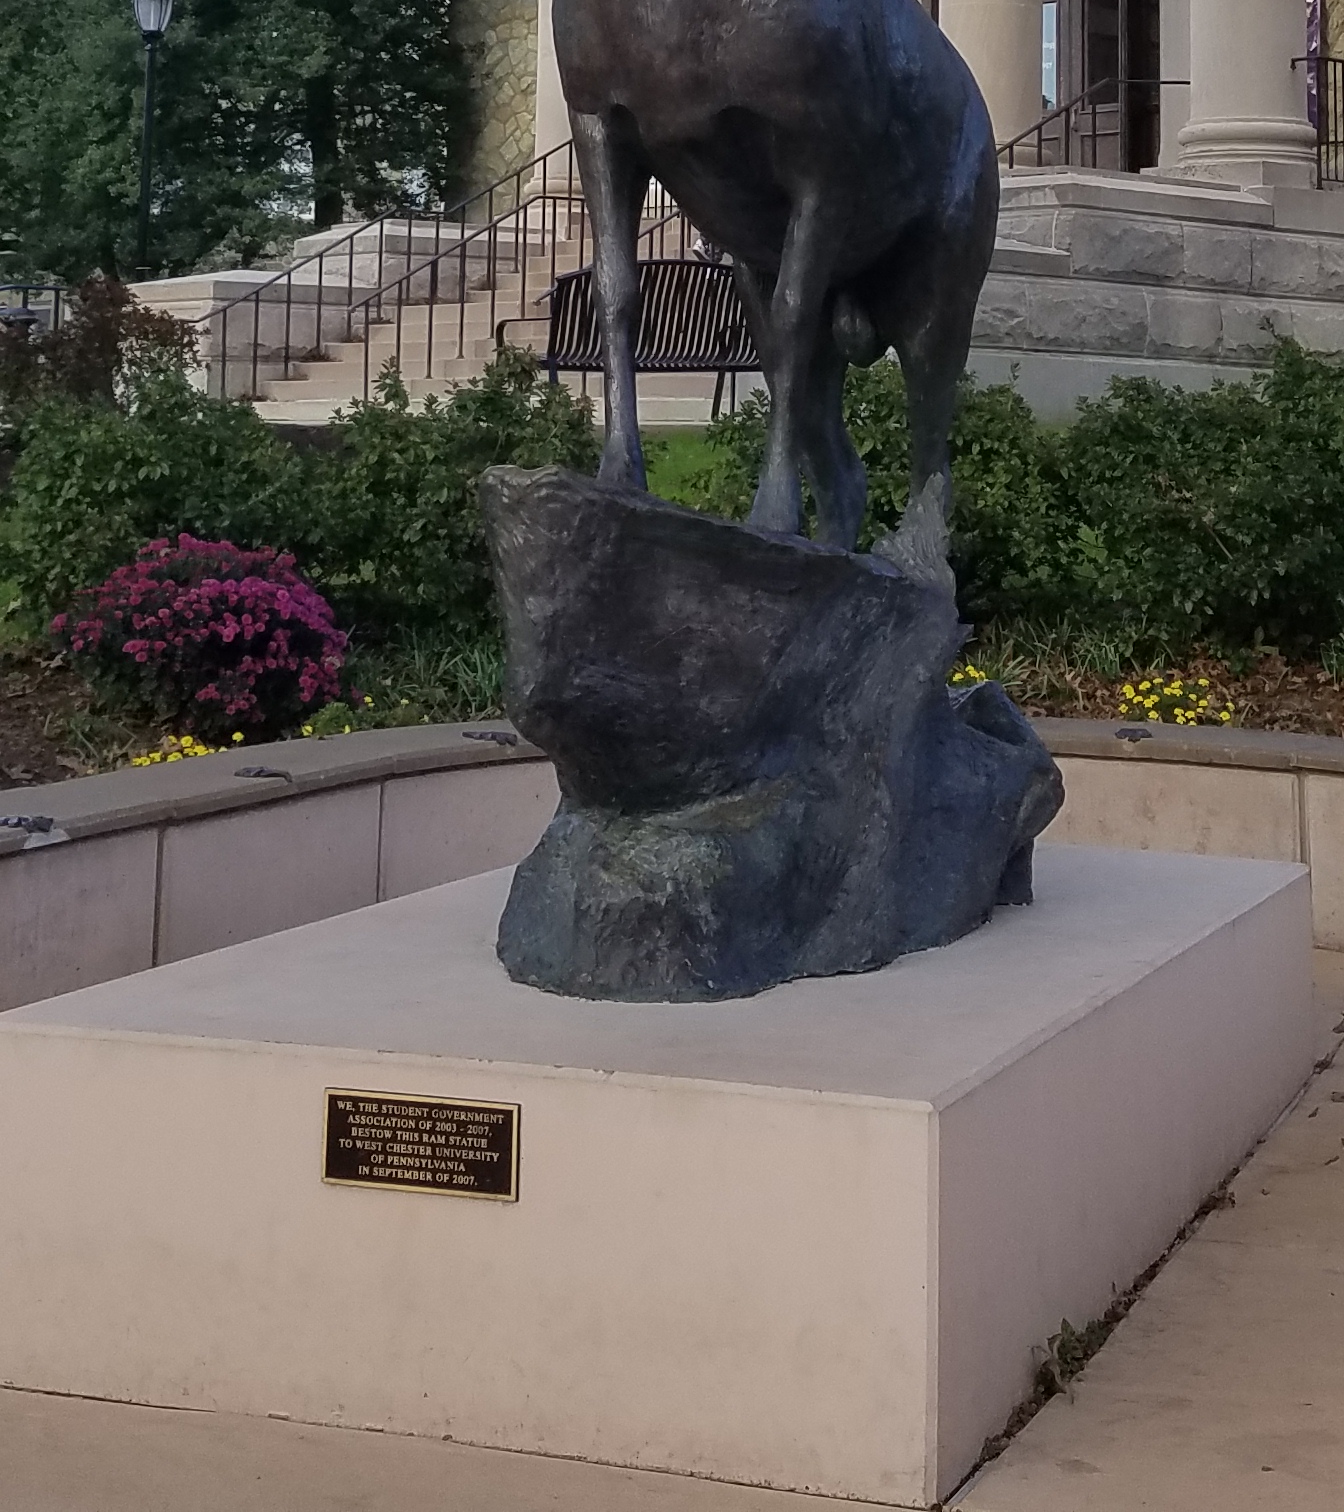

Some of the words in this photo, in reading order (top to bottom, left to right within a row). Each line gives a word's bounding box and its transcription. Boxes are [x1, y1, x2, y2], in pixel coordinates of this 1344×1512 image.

[337, 1100, 355, 1112] WE,
[358, 1102, 379, 1113] THE
[381, 1104, 429, 1118] STUDENT
[431, 1109, 504, 1124] GOVERNMENT
[347, 1114, 416, 1129] ASSOCIATION
[418, 1120, 433, 1131] OF
[434, 1121, 457, 1133] 2003
[351, 1126, 393, 1139] BESTOW
[396, 1130, 419, 1142] THIS
[422, 1133, 446, 1144] RAM
[448, 1136, 488, 1148] STATUE
[338, 1138, 353, 1148] TO
[355, 1140, 383, 1152] WEST
[386, 1143, 432, 1156] CHESTER
[435, 1147, 500, 1162] UNIVERSITY
[370, 1154, 385, 1164] OF
[387, 1155, 466, 1172] PENNSYLVANIA
[358, 1165, 370, 1176] IN
[372, 1167, 433, 1182] SEPTEMBER
[435, 1172, 450, 1183] OF
